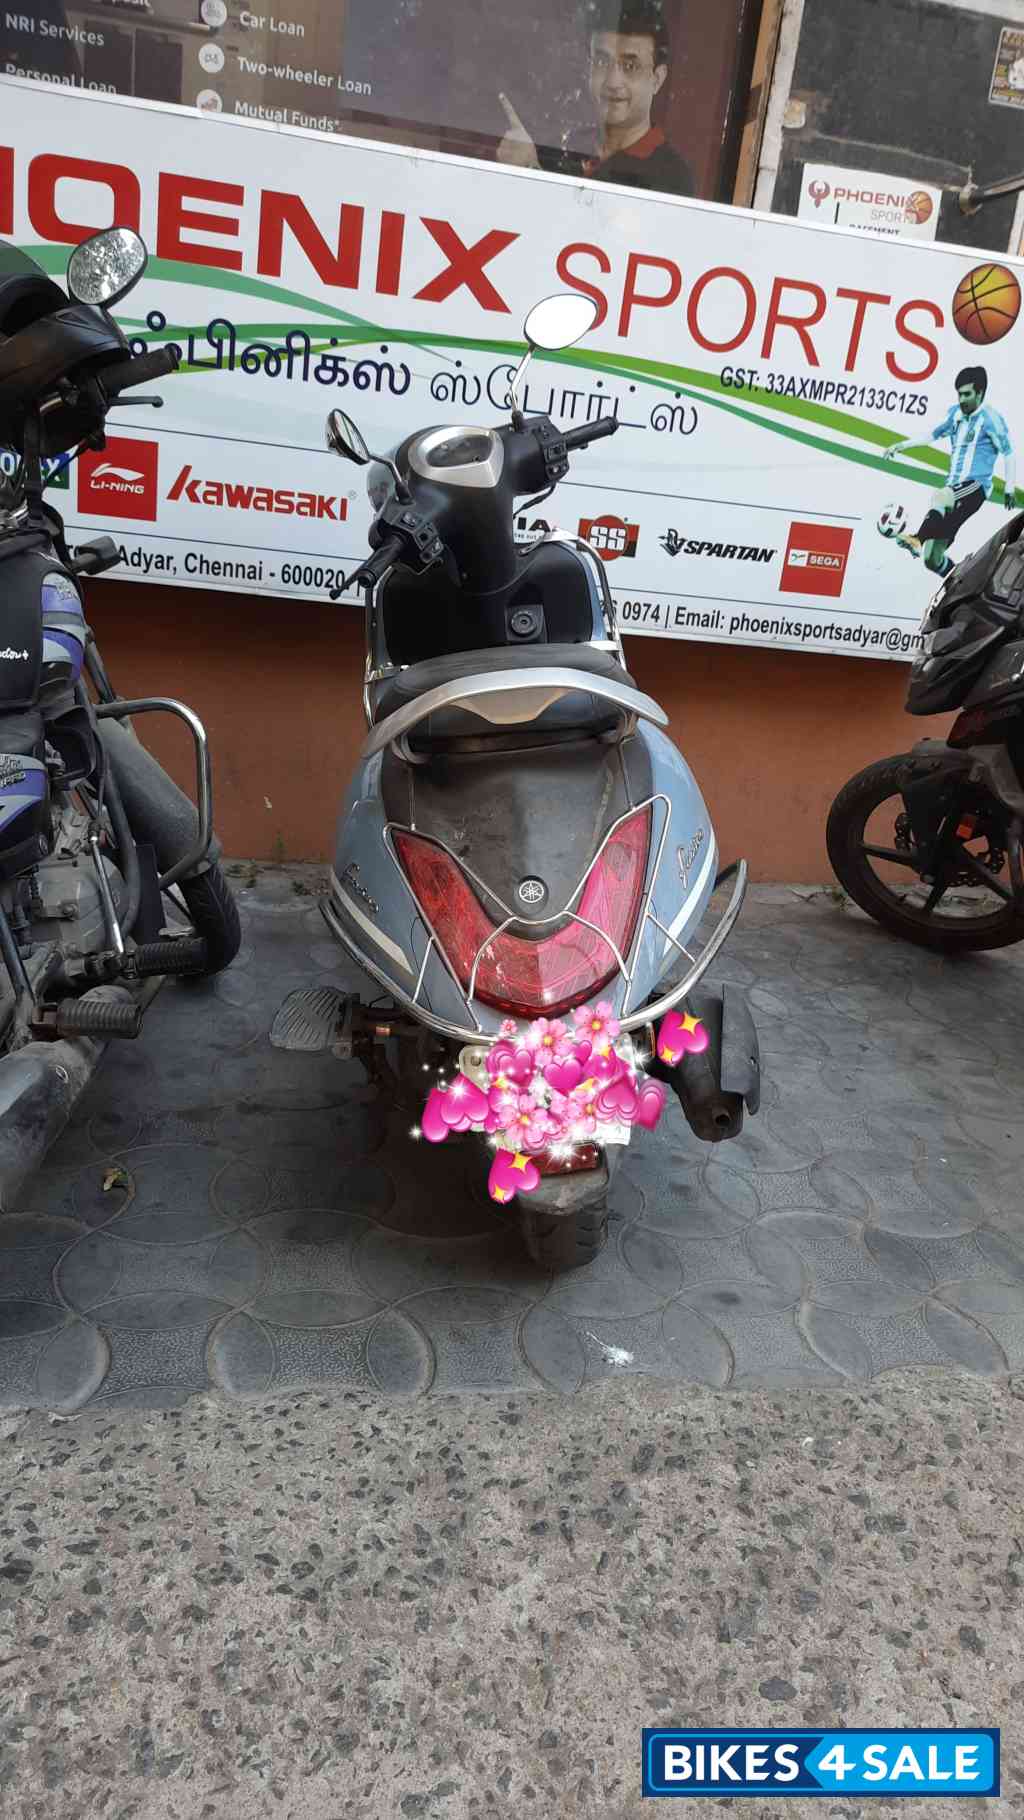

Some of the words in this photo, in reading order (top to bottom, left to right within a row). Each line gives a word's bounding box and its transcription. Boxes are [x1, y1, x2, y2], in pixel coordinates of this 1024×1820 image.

[5, 13, 35, 33] NRI
[40, 20, 105, 46] Services
[239, 11, 265, 30] Car
[269, 19, 305, 37] Loan
[238, 56, 333, 88] Two-wheeler
[337, 78, 372, 96] Loan
[235, 100, 288, 122] Mutual
[556, 242, 944, 382] SPORTS
[720, 366, 760, 394] GST:
[90, 480, 145, 494] LI-NING
[118, 545, 177, 575] Adyar,
[184, 553, 262, 581] Chennai
[683, 540, 775, 563] SPARTAN
[809, 555, 840, 567] SEGA
[622, 601, 661, 623] 0974
[675, 606, 725, 629] Email:
[730, 615, 925, 650] phoenixsportsadyar@gm
